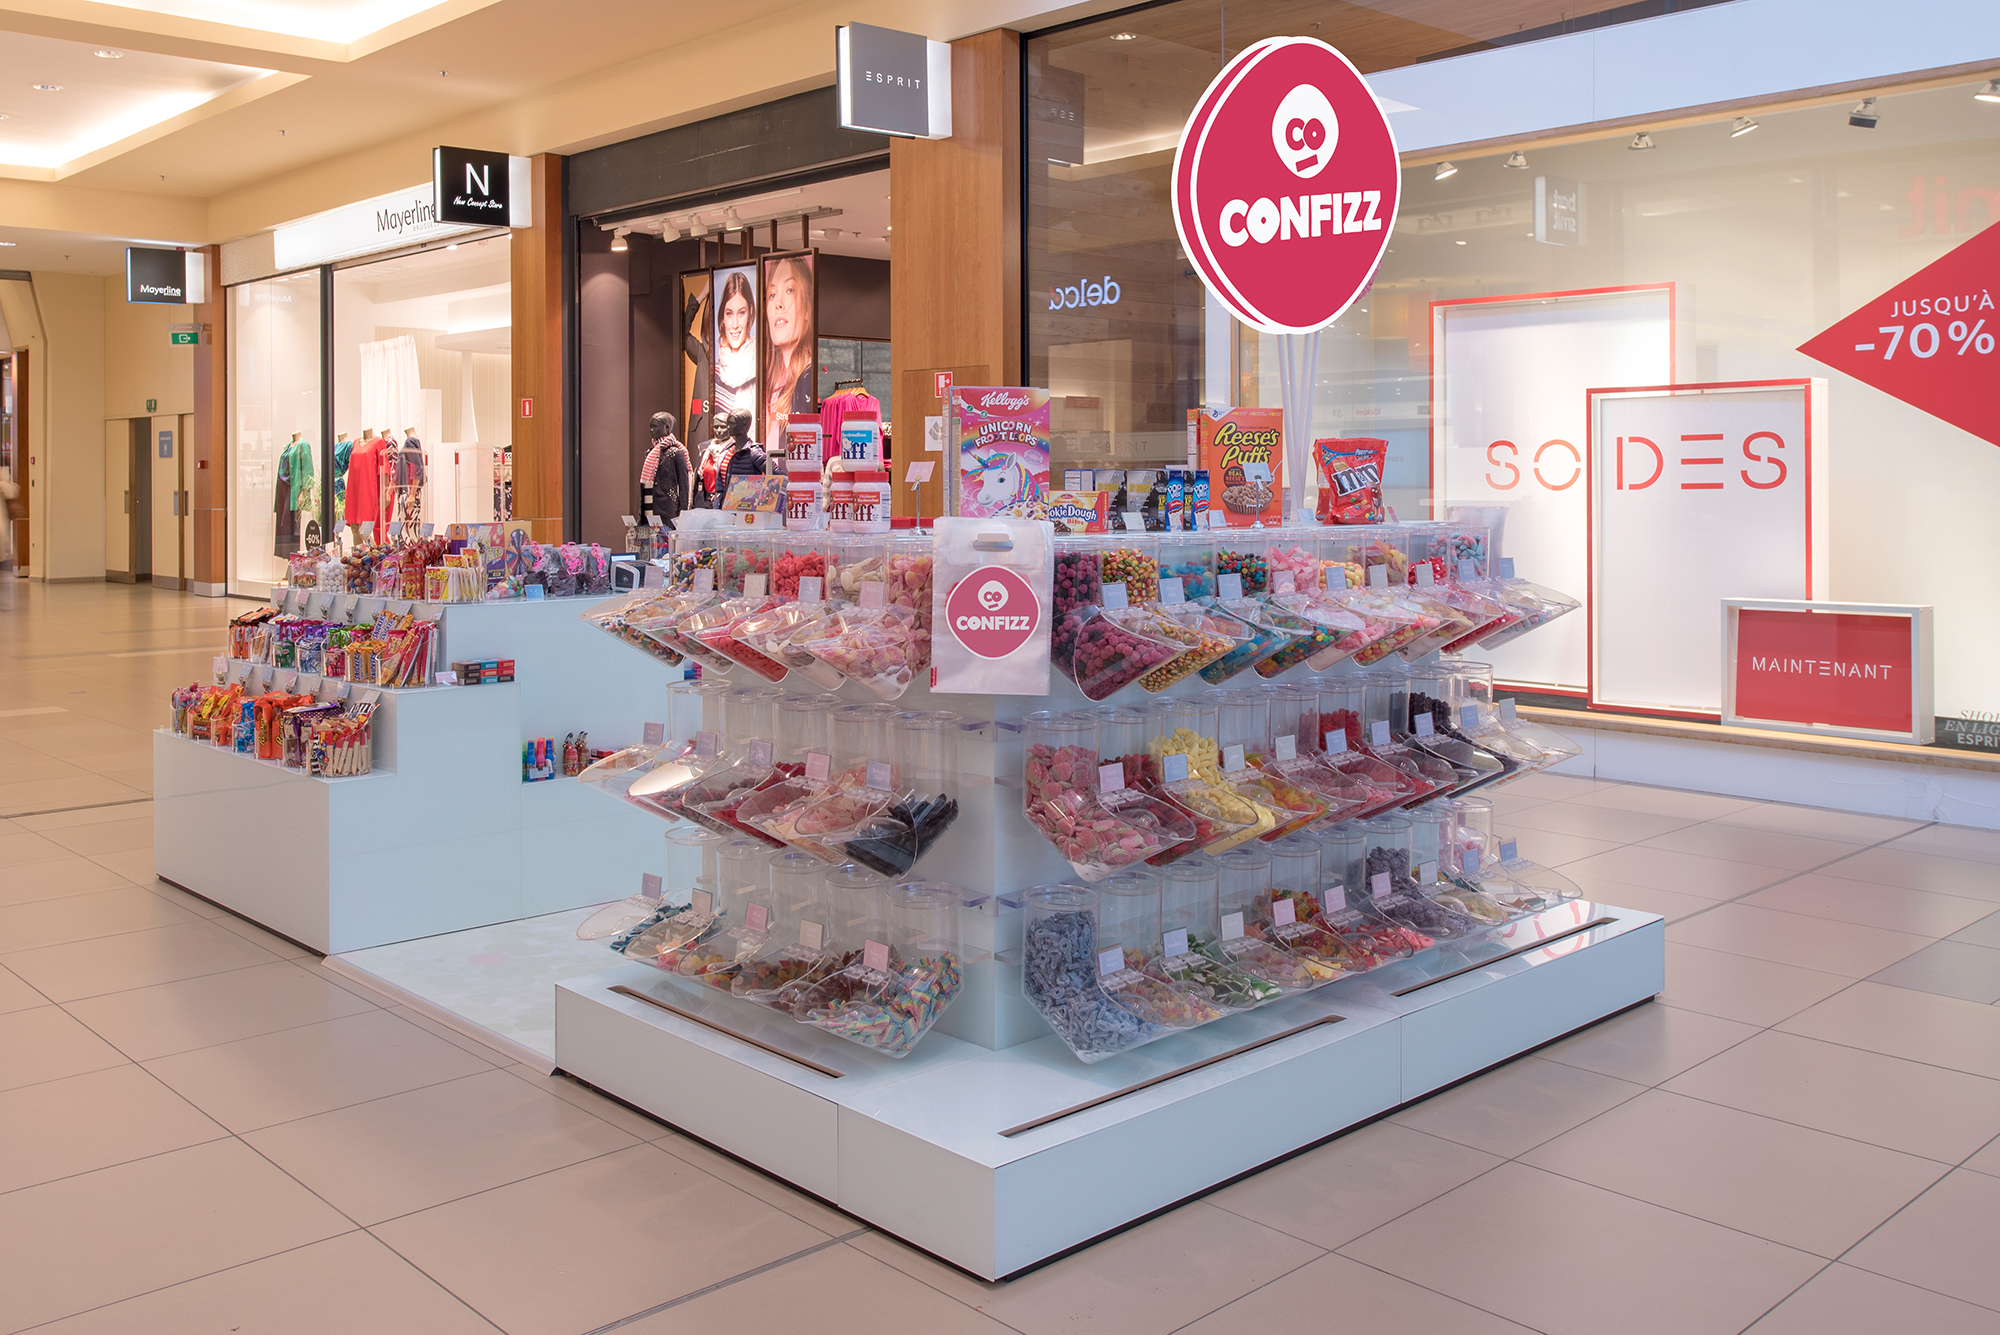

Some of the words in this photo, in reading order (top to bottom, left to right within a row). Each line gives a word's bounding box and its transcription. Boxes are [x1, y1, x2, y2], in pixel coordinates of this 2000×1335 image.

[865, 71, 921, 89] ESPRIT
[1285, 117, 1326, 151] CO
[466, 162, 489, 196] N
[376, 199, 435, 235] Mayerline
[1218, 190, 1382, 247] CONFIZZ
[1891, 289, 1995, 318] JUSQU'À
[980, 391, 1031, 411] Kellogg's
[980, 421, 1032, 435] UNICORN
[1214, 421, 1280, 446] Reese's
[1221, 446, 1271, 469] Puffs
[1049, 505, 1067, 518] okie
[1067, 505, 1097, 521] Dough
[983, 591, 1003, 603] CO
[956, 616, 1030, 631] CONFIZZ
[1752, 656, 1892, 680] MAINTENANT
[1944, 720, 1970, 733] EN
[1970, 722, 2000, 736] LIG
[1957, 732, 2000, 748] ESPRI
